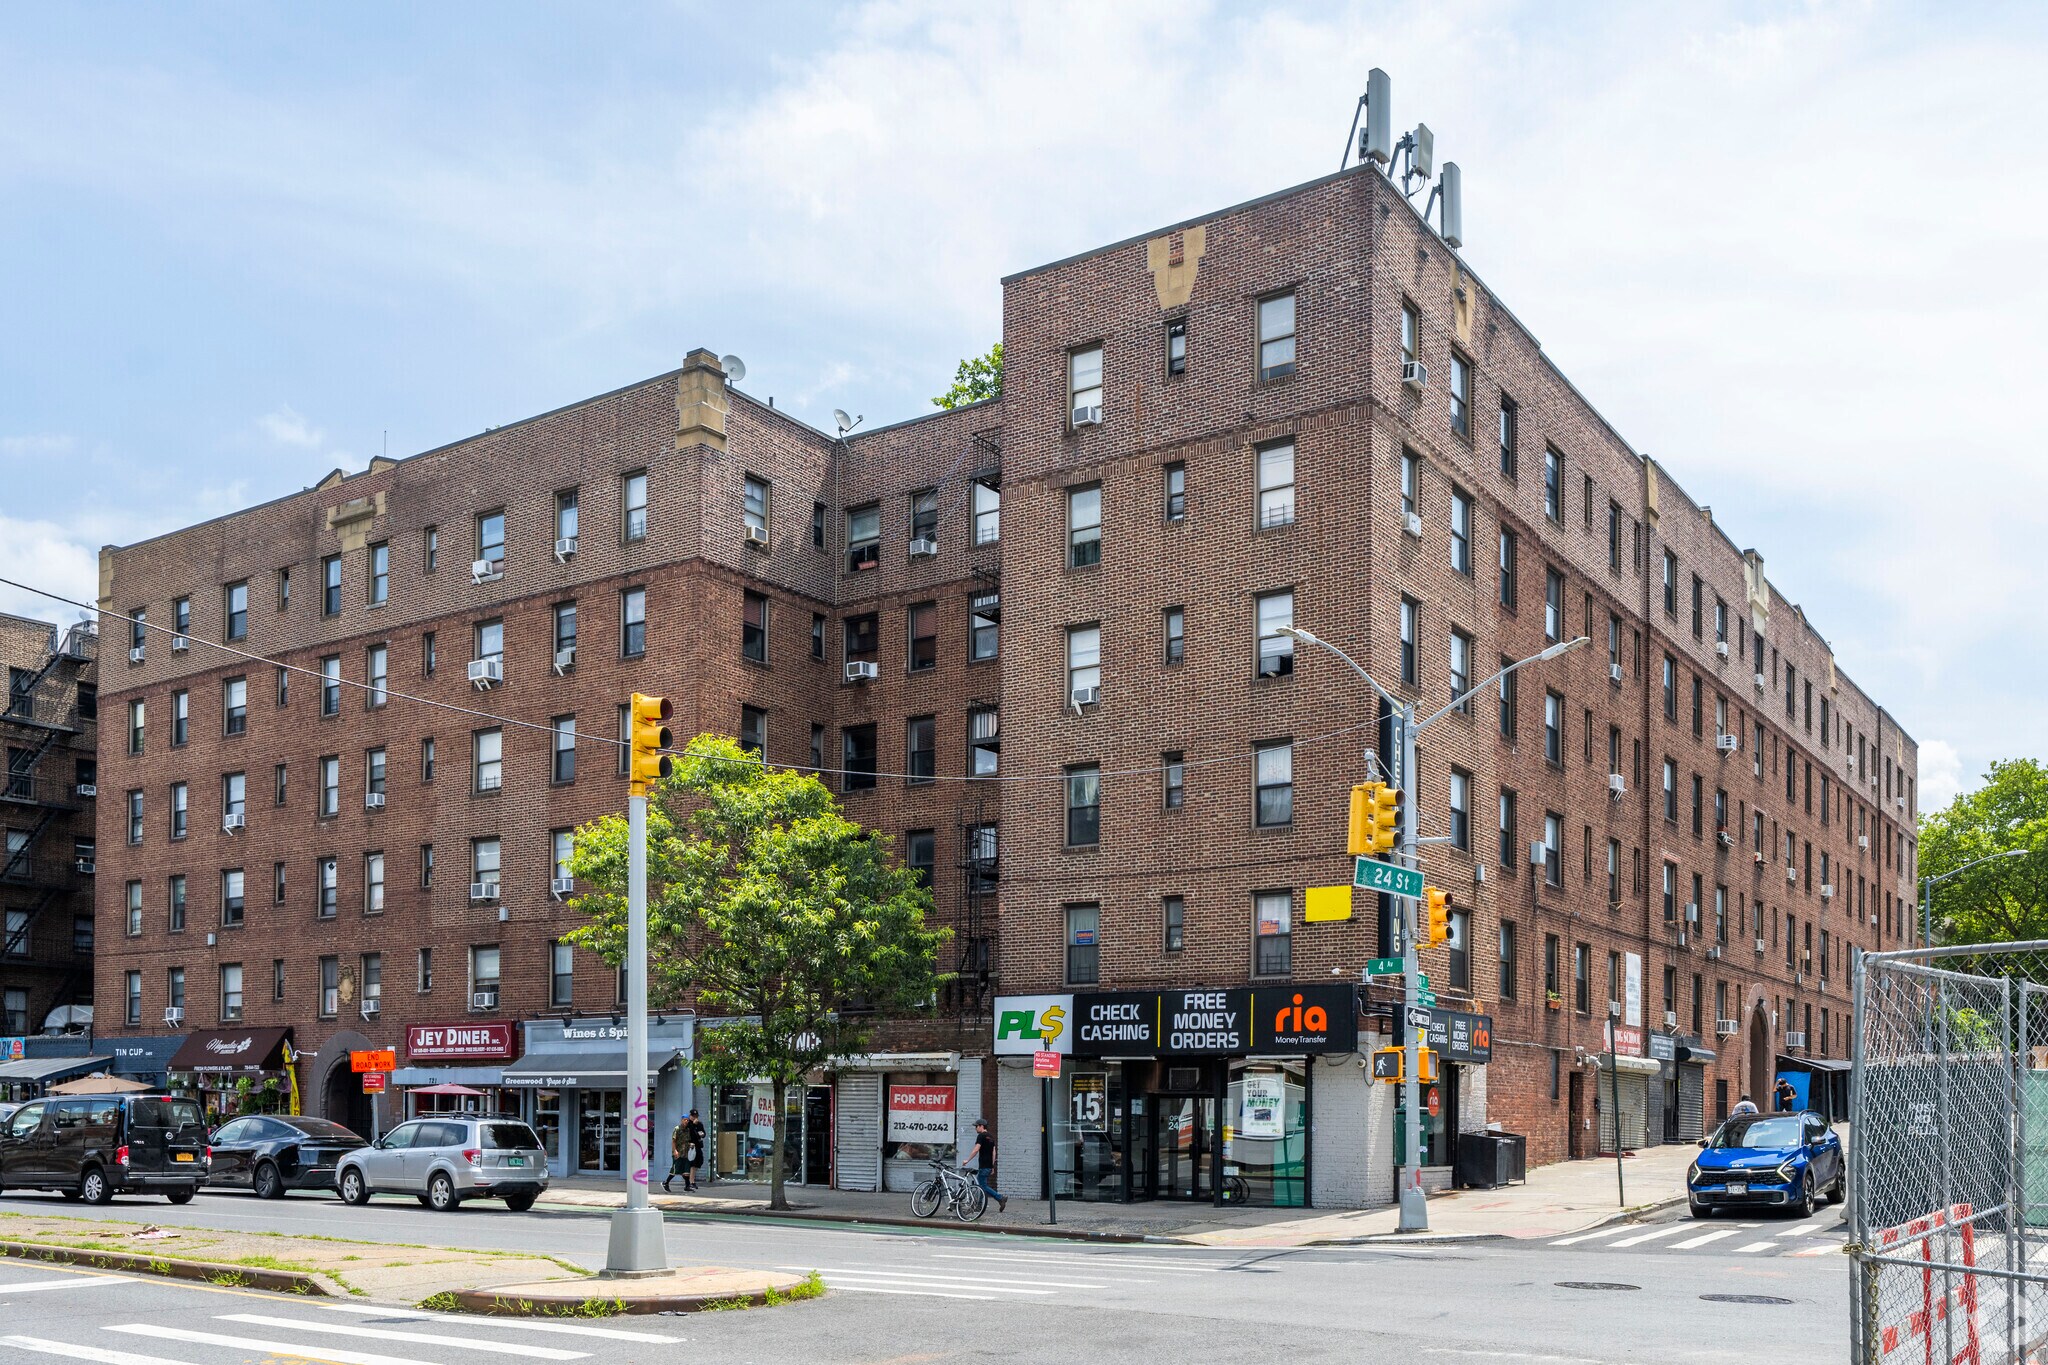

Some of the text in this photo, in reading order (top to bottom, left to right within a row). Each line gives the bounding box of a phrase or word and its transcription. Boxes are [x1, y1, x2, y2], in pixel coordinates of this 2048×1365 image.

[1374, 867, 1410, 890] 24 St
[1378, 961, 1384, 971] 4
[1184, 993, 1227, 1010] FREE
[1090, 1004, 1140, 1021] CHECK
[1275, 993, 1327, 1032] ria
[1174, 1012, 1237, 1030] MONEY
[1455, 1020, 1466, 1031] FREE
[1081, 1024, 1150, 1041] CASHING
[1431, 1022, 1445, 1033] CHECK
[416, 1029, 443, 1046] JEY
[446, 1028, 490, 1045] DINER
[563, 1027, 628, 1040] Wines & Spi
[1429, 1033, 1448, 1044] CASHING
[1452, 1031, 1468, 1041] MONEY
[1473, 1020, 1489, 1047] ria
[1170, 1032, 1239, 1049] ORDERS
[1275, 1035, 1327, 1045] Money Transfer
[1452, 1041, 1469, 1051] ORDERS
[115, 1048, 127, 1056] TIN
[129, 1048, 143, 1056] CUP
[367, 1053, 379, 1061] END
[355, 1061, 371, 1069] ROAD
[1246, 1080, 1260, 1088] GET
[1246, 1089, 1268, 1097] YOUR
[1429, 1092, 1439, 1105] ria
[758, 1098, 774, 1110] GRA
[894, 1093, 948, 1105] FOR RENT
[1246, 1098, 1280, 1108] MONEY
[753, 1113, 775, 1127] OPEN
[893, 1122, 949, 1131] 212-470-0242
